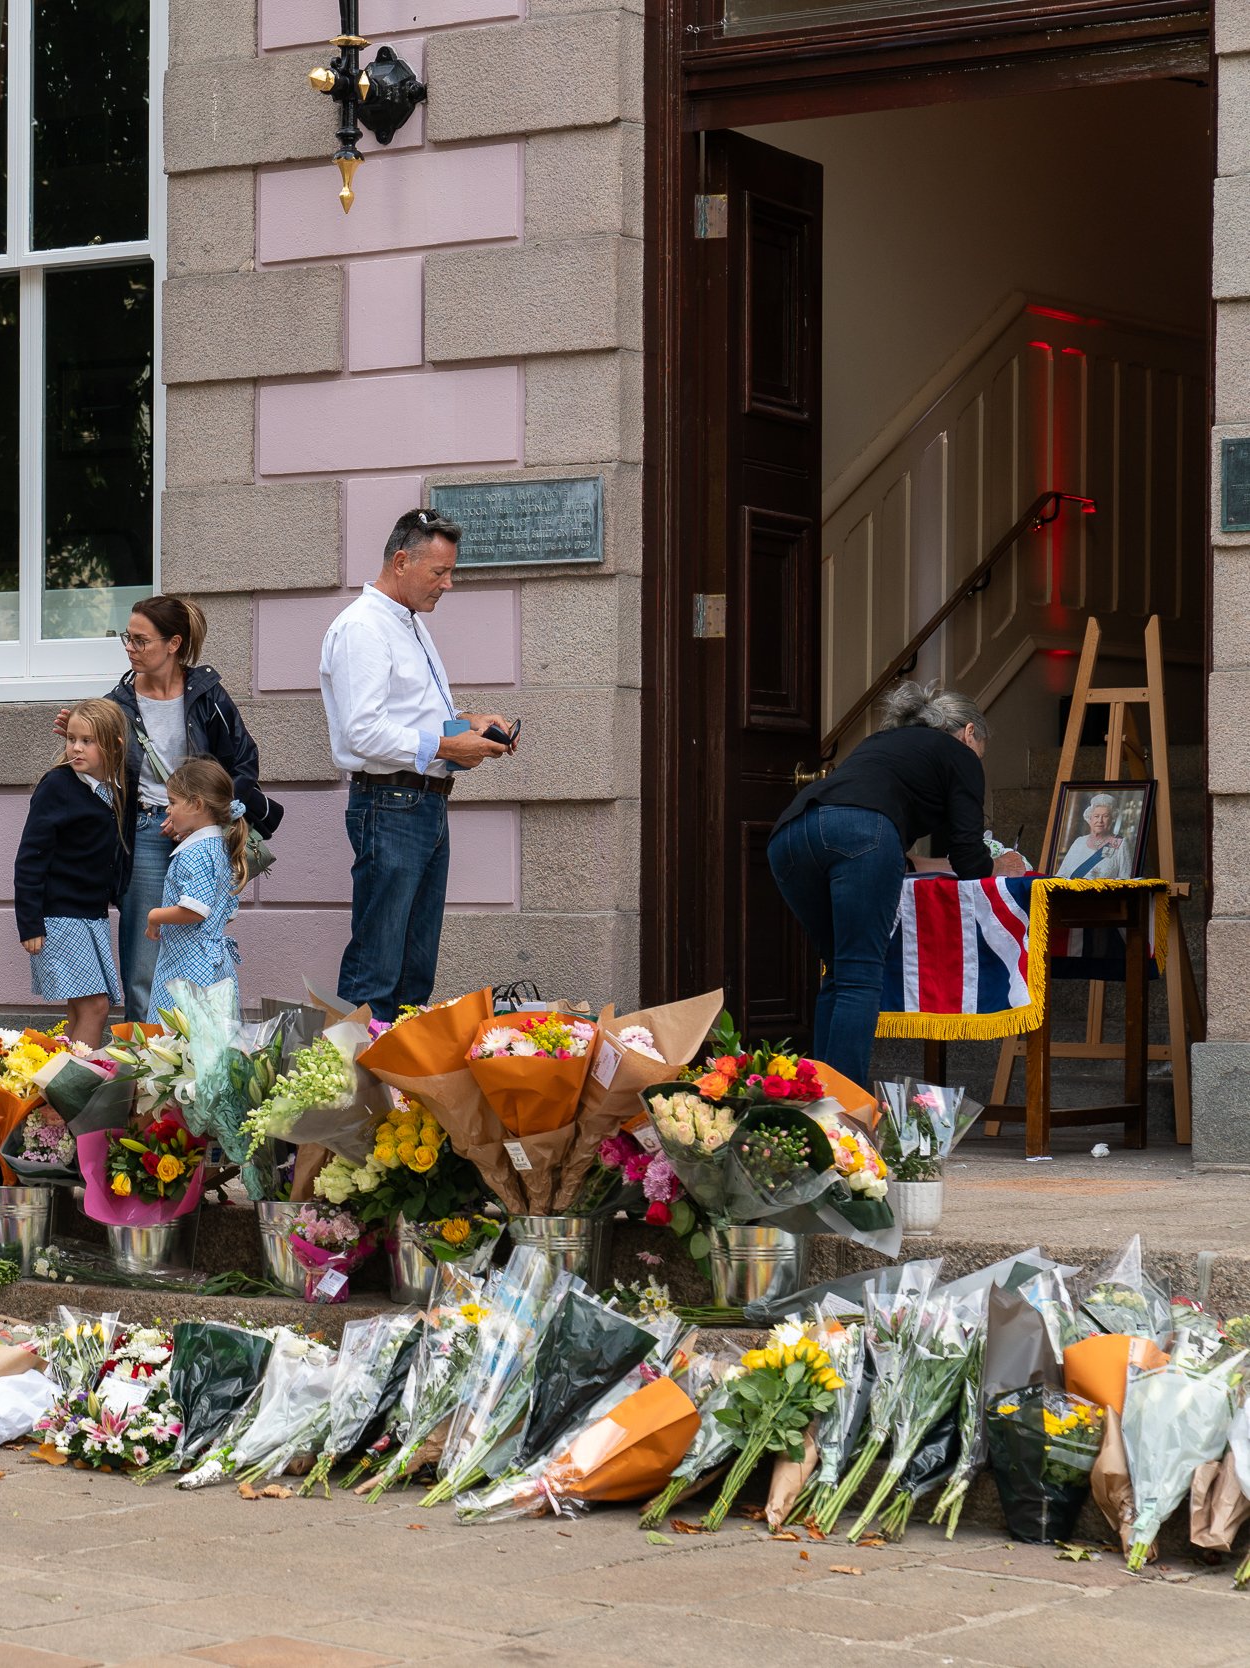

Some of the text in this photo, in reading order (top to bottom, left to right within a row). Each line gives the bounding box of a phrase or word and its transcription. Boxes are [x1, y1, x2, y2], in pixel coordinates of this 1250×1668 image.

[464, 494, 481, 503] THE
[486, 493, 511, 502] ROYAL
[441, 508, 461, 517] THIS
[463, 507, 488, 516] DOOR
[490, 505, 514, 514] WERE
[470, 519, 486, 529] THE
[491, 518, 515, 528] DOOR
[520, 517, 531, 526] OF
[535, 515, 552, 525] THE
[468, 532, 497, 541] COURT
[501, 530, 528, 540] HOUSE
[556, 528, 568, 537] ON
[572, 526, 591, 536] THIS
[460, 545, 495, 555] BETWEEN
[497, 543, 513, 553] THE
[515, 542, 540, 552] YEARS
